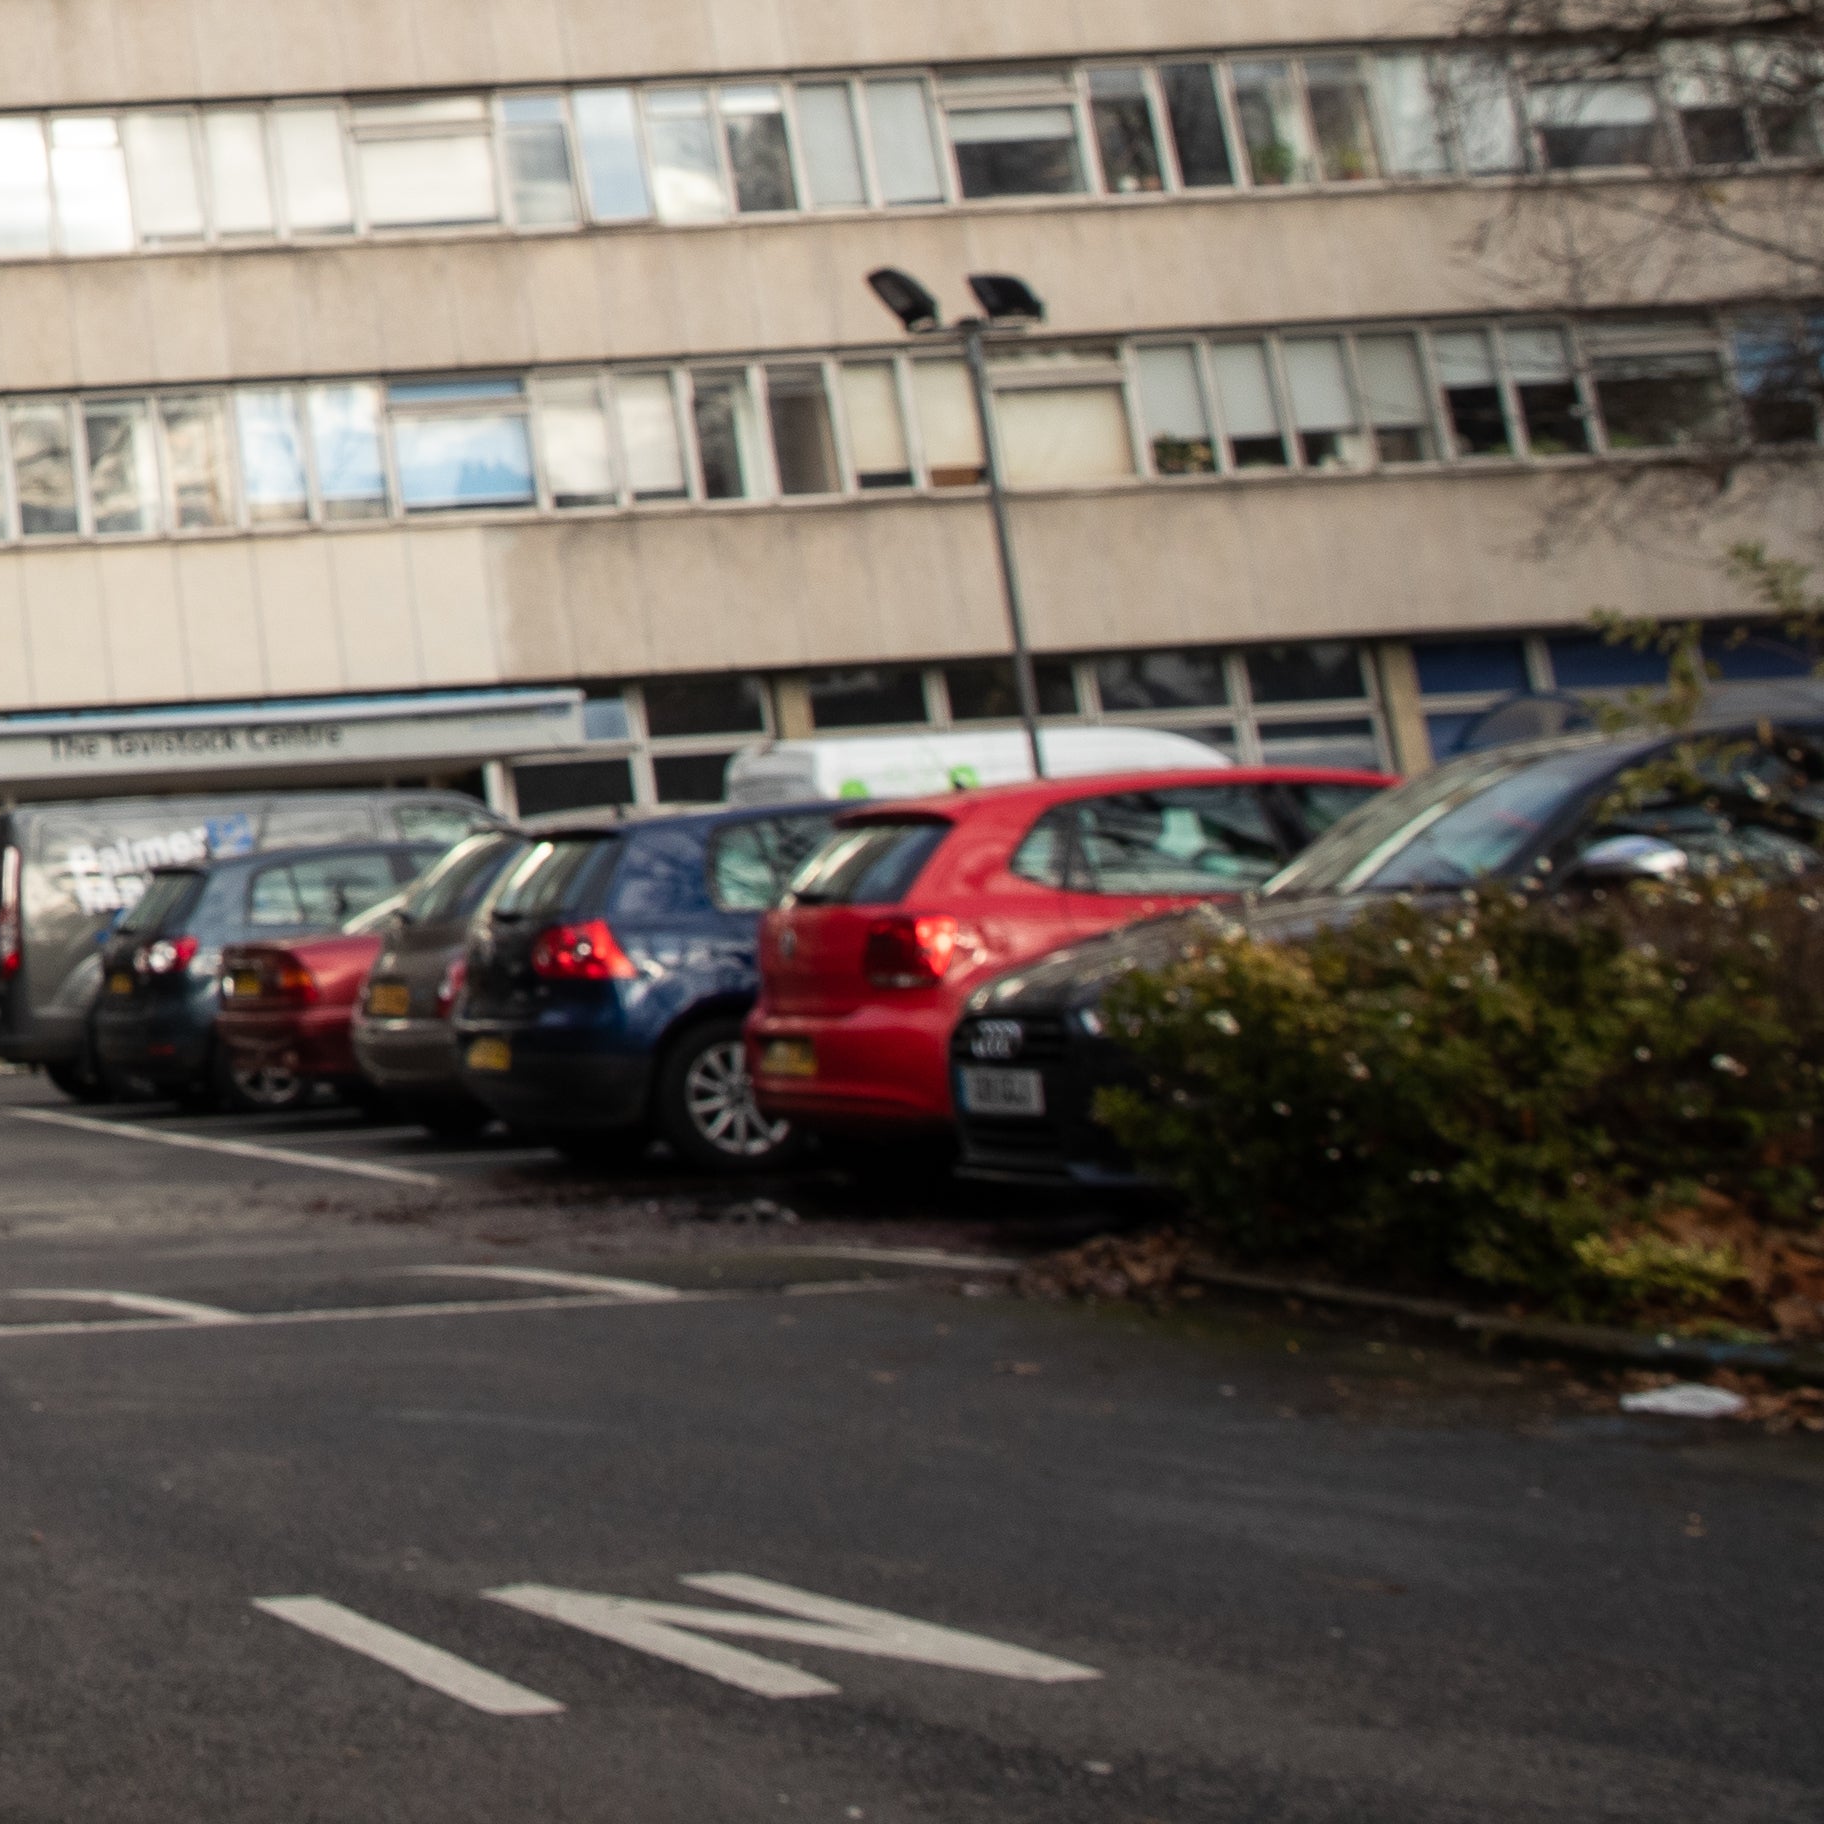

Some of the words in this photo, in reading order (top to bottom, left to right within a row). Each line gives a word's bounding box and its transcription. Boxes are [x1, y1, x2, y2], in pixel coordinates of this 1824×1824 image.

[53, 728, 99, 760] The
[109, 728, 236, 756] Tavistock
[247, 722, 344, 749] Centre
[252, 1572, 1104, 1716] IN
